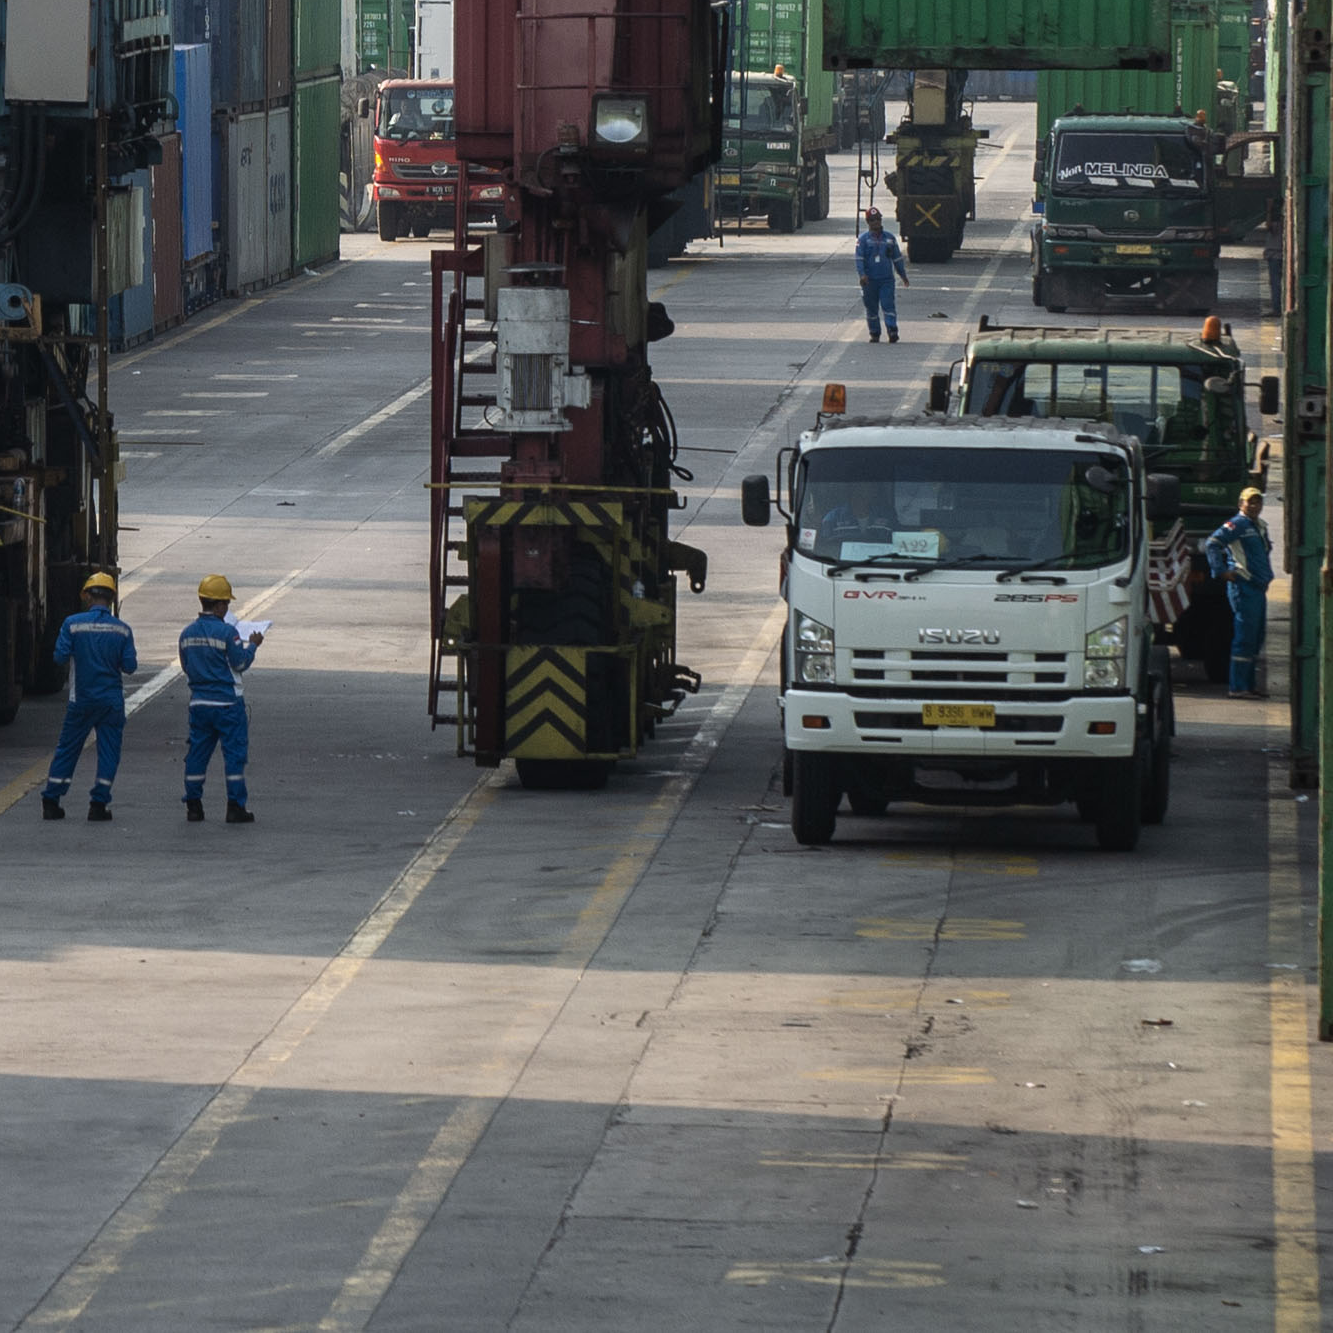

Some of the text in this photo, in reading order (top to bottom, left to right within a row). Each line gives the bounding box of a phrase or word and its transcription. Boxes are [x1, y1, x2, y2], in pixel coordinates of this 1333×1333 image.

[1060, 162, 1169, 180] Non MELINDA
[843, 590, 897, 599] GVR
[918, 628, 1000, 645] ISUZU
